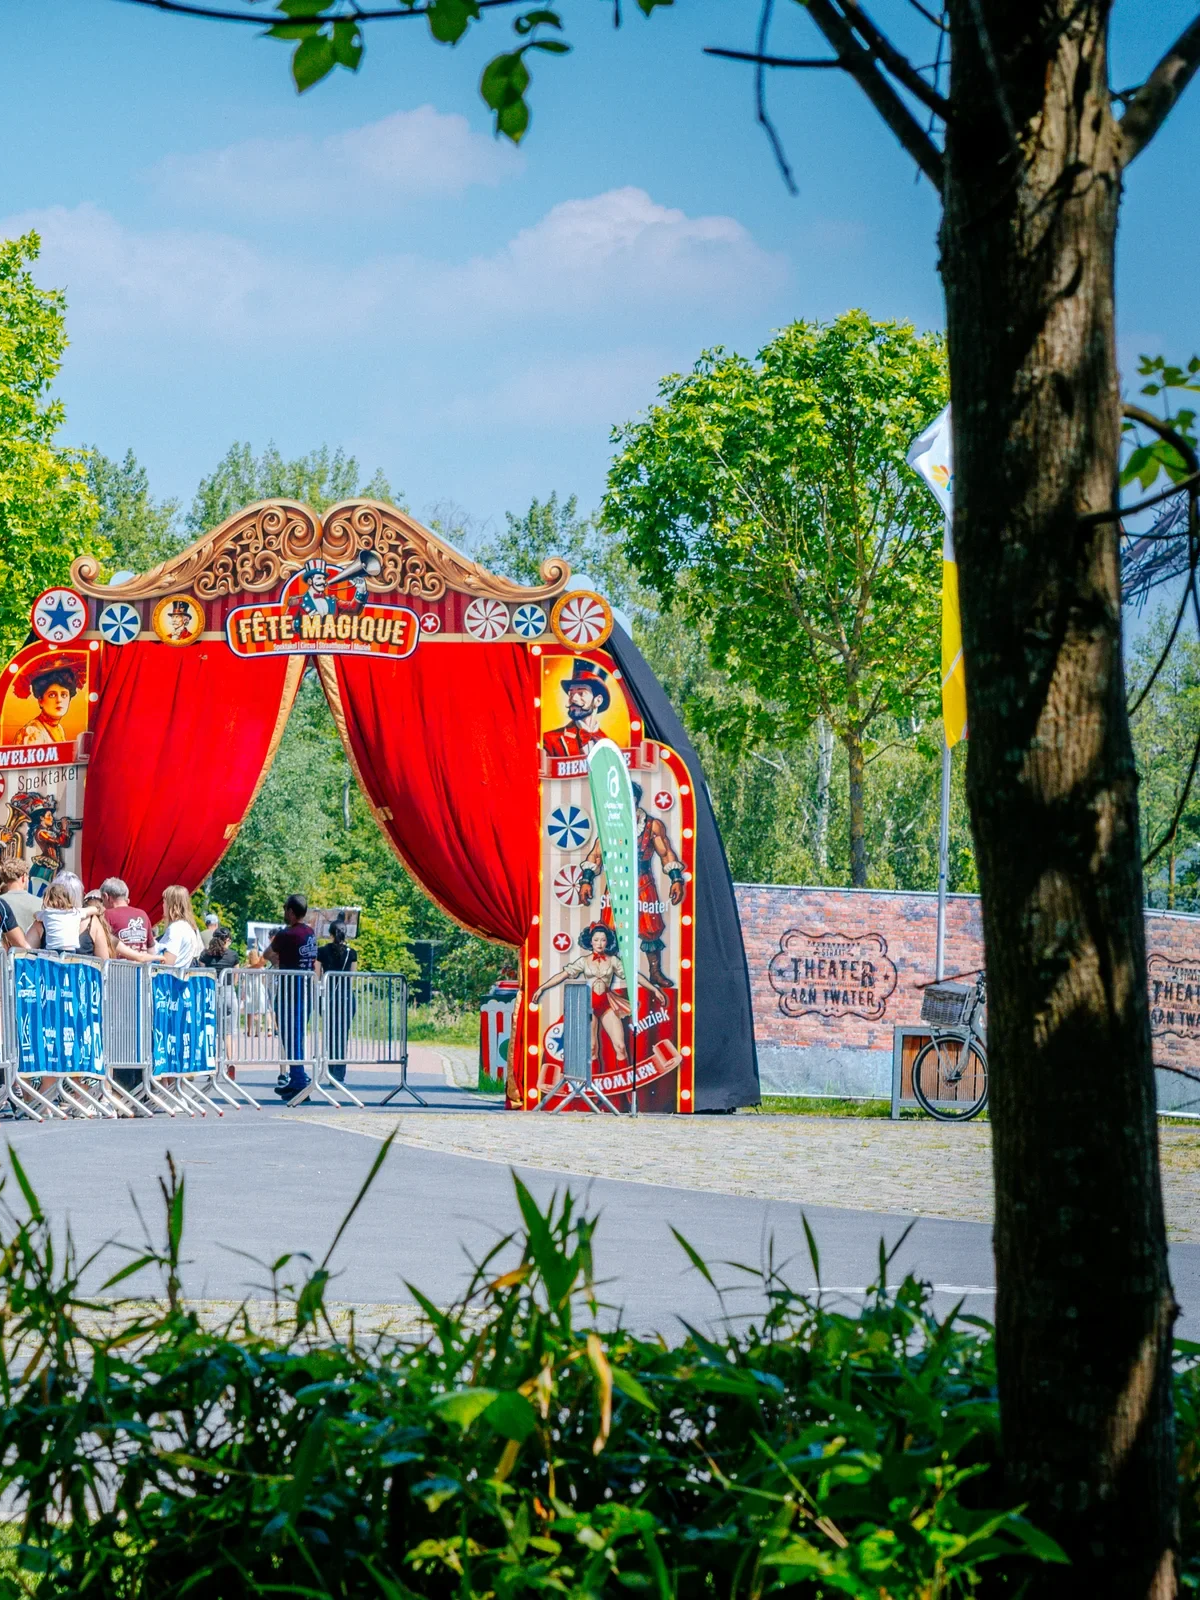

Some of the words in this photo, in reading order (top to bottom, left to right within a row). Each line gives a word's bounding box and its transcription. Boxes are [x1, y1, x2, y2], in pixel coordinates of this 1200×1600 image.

[238, 611, 294, 644] FÊTE
[302, 613, 408, 645] MAGIQUE
[557, 752, 631, 777] BIENE
[17, 765, 80, 793] Spektakel
[791, 958, 877, 989] THEATER
[791, 988, 817, 1005] AAN
[823, 989, 875, 1007] TWATER
